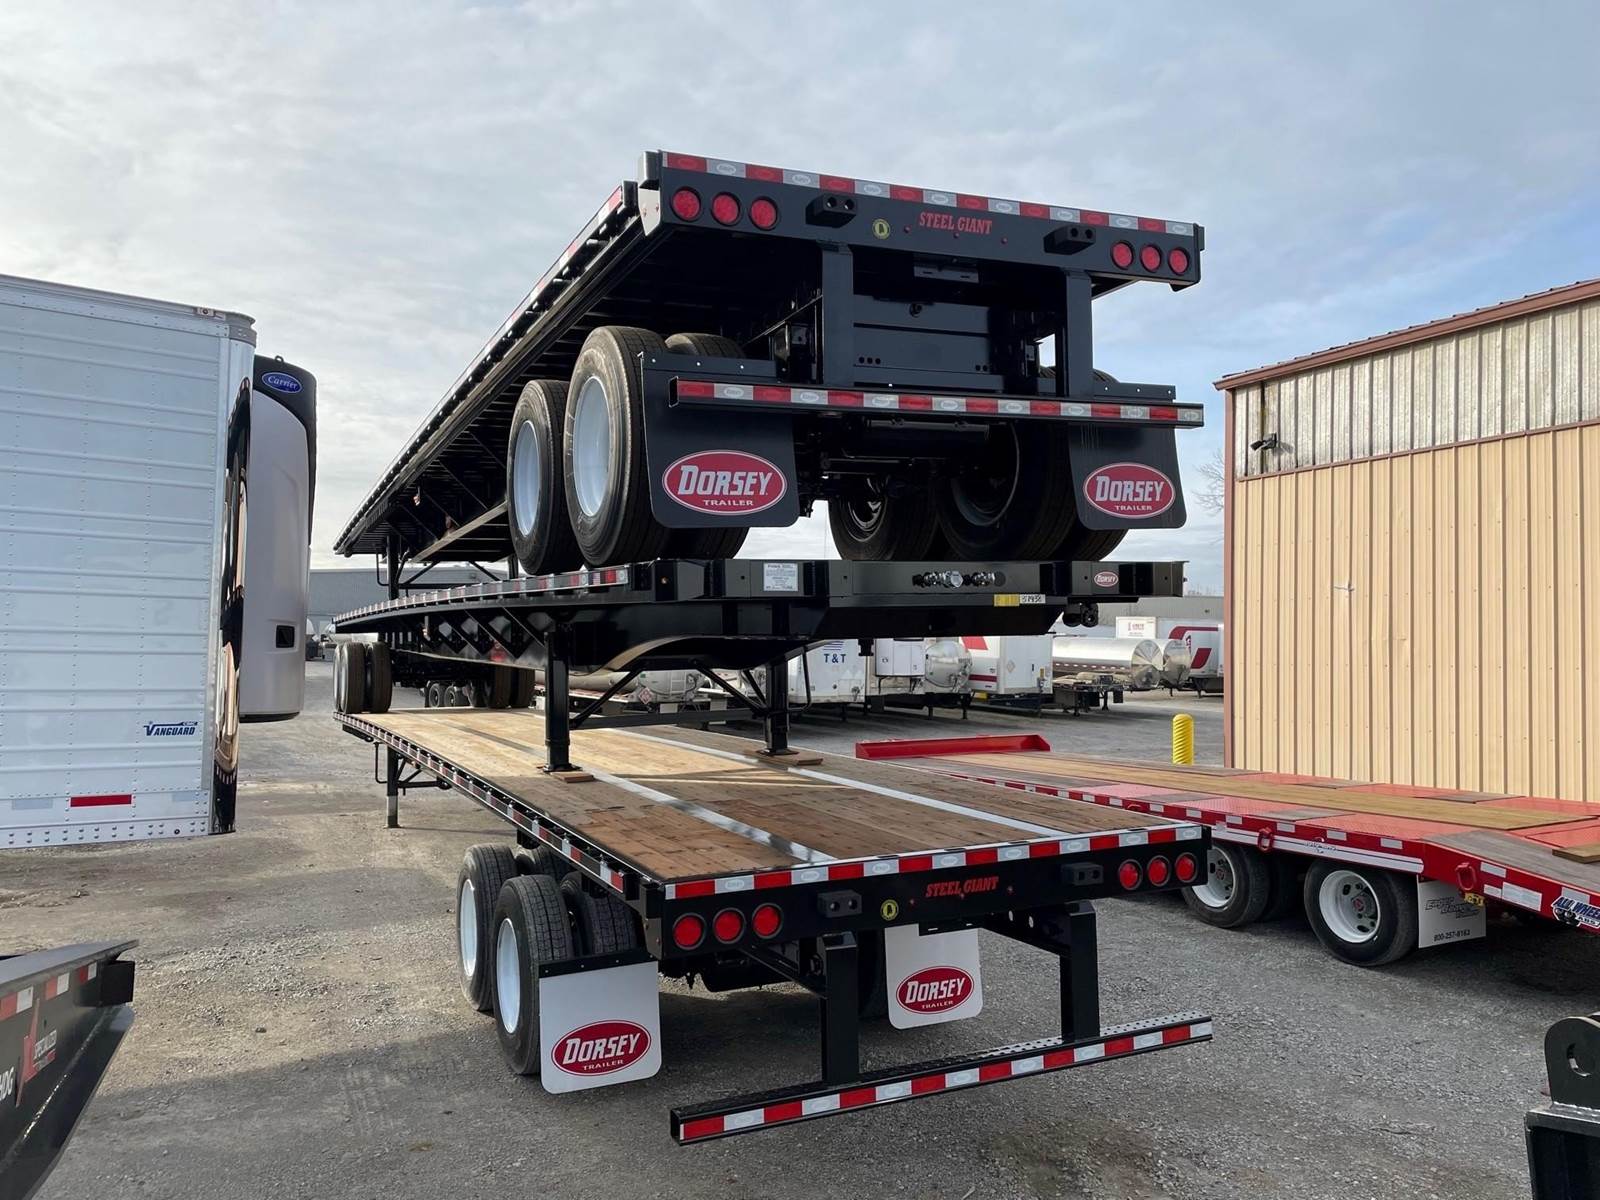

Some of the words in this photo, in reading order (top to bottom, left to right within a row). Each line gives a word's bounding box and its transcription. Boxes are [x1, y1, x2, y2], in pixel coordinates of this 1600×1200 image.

[919, 211, 955, 230] STEEL
[957, 216, 993, 234] GIANT
[267, 375, 299, 389] Carrier
[677, 465, 773, 496] DORSEY
[1095, 475, 1165, 502] DORSEY
[702, 499, 754, 507] TRAILER
[143, 723, 197, 737] VANGUARD
[925, 880, 962, 898] STEEL
[963, 876, 1000, 894] GIANT
[905, 977, 966, 1004] DORSEY
[921, 1000, 955, 1009] TRAILER
[562, 1032, 641, 1065] DORSEY
[583, 1059, 624, 1071] TRAILER
